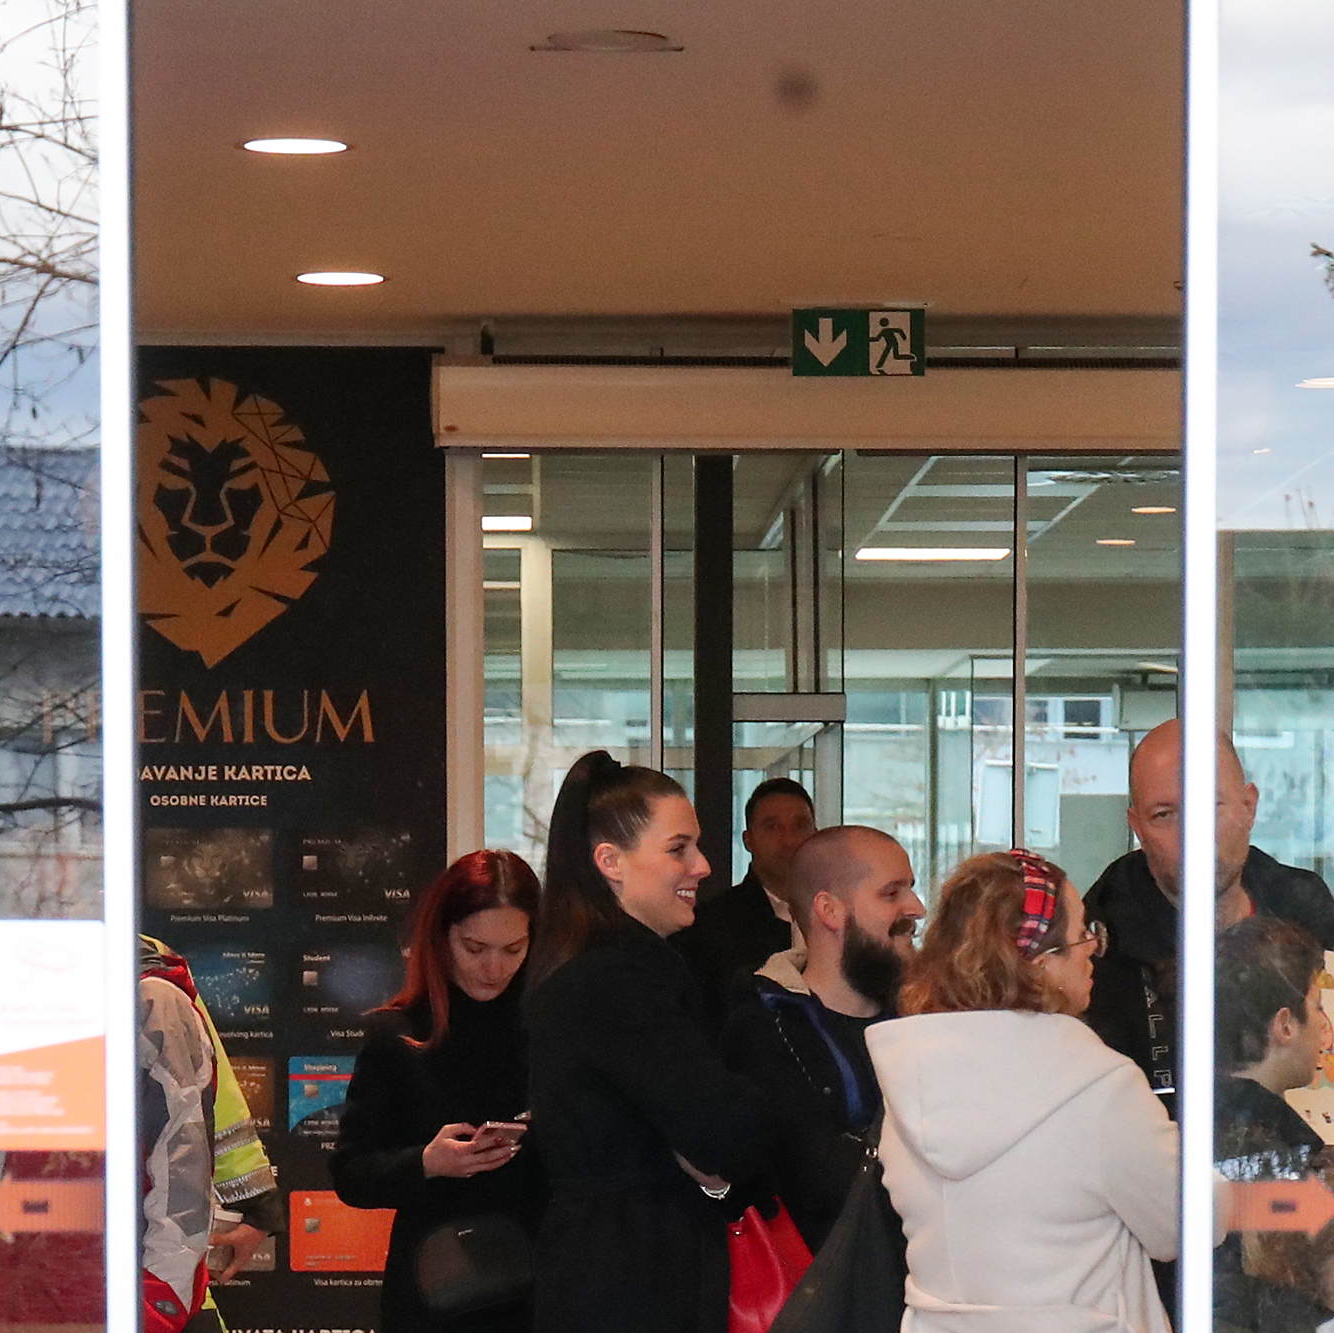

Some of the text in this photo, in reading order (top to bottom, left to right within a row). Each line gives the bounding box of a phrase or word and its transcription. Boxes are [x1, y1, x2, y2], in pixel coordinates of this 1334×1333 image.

[137, 765, 312, 781] AVANJE KARTICA
[149, 795, 268, 806] OSOBNE KARTICE
[383, 888, 411, 899] VISA
